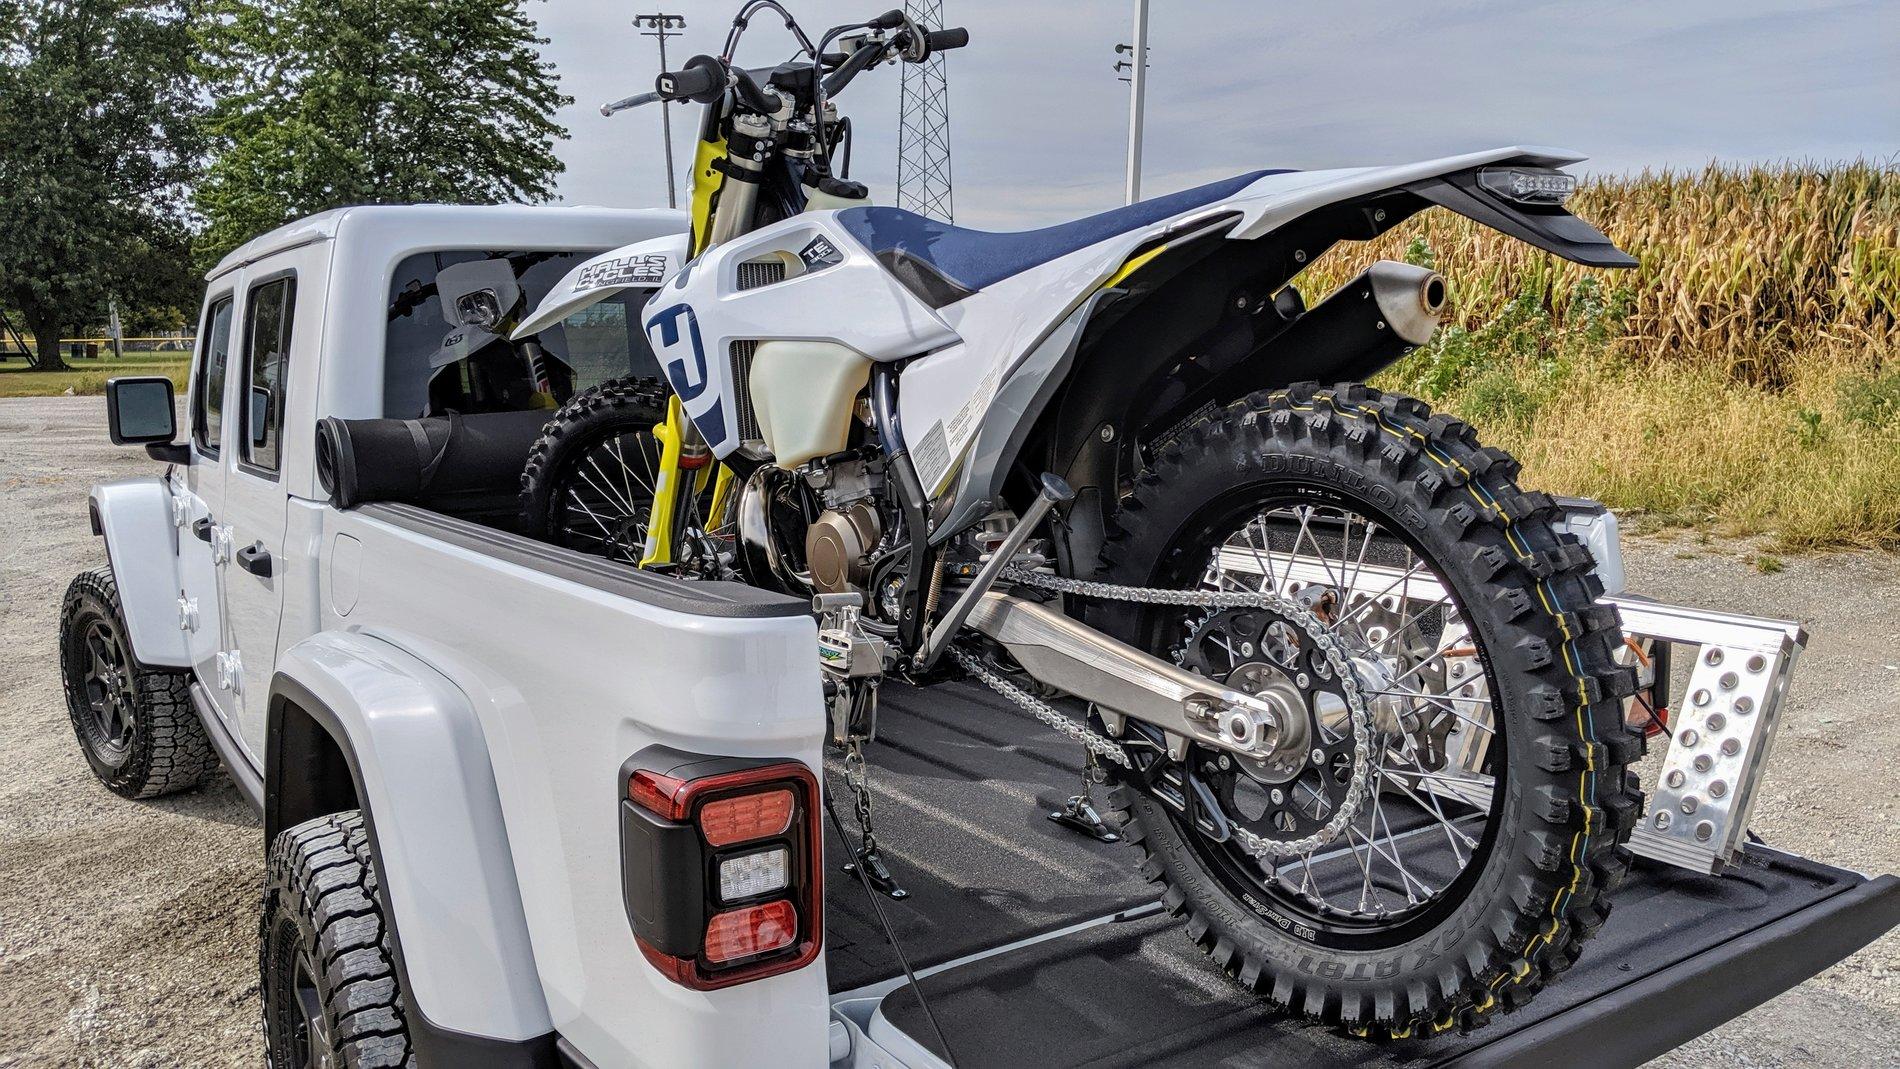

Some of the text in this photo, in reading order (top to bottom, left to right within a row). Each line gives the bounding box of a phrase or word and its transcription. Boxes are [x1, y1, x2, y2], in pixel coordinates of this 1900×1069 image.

[803, 241, 829, 259] TE
[1262, 453, 1428, 530] DUNLOP
[1297, 953, 1403, 983] AT81
